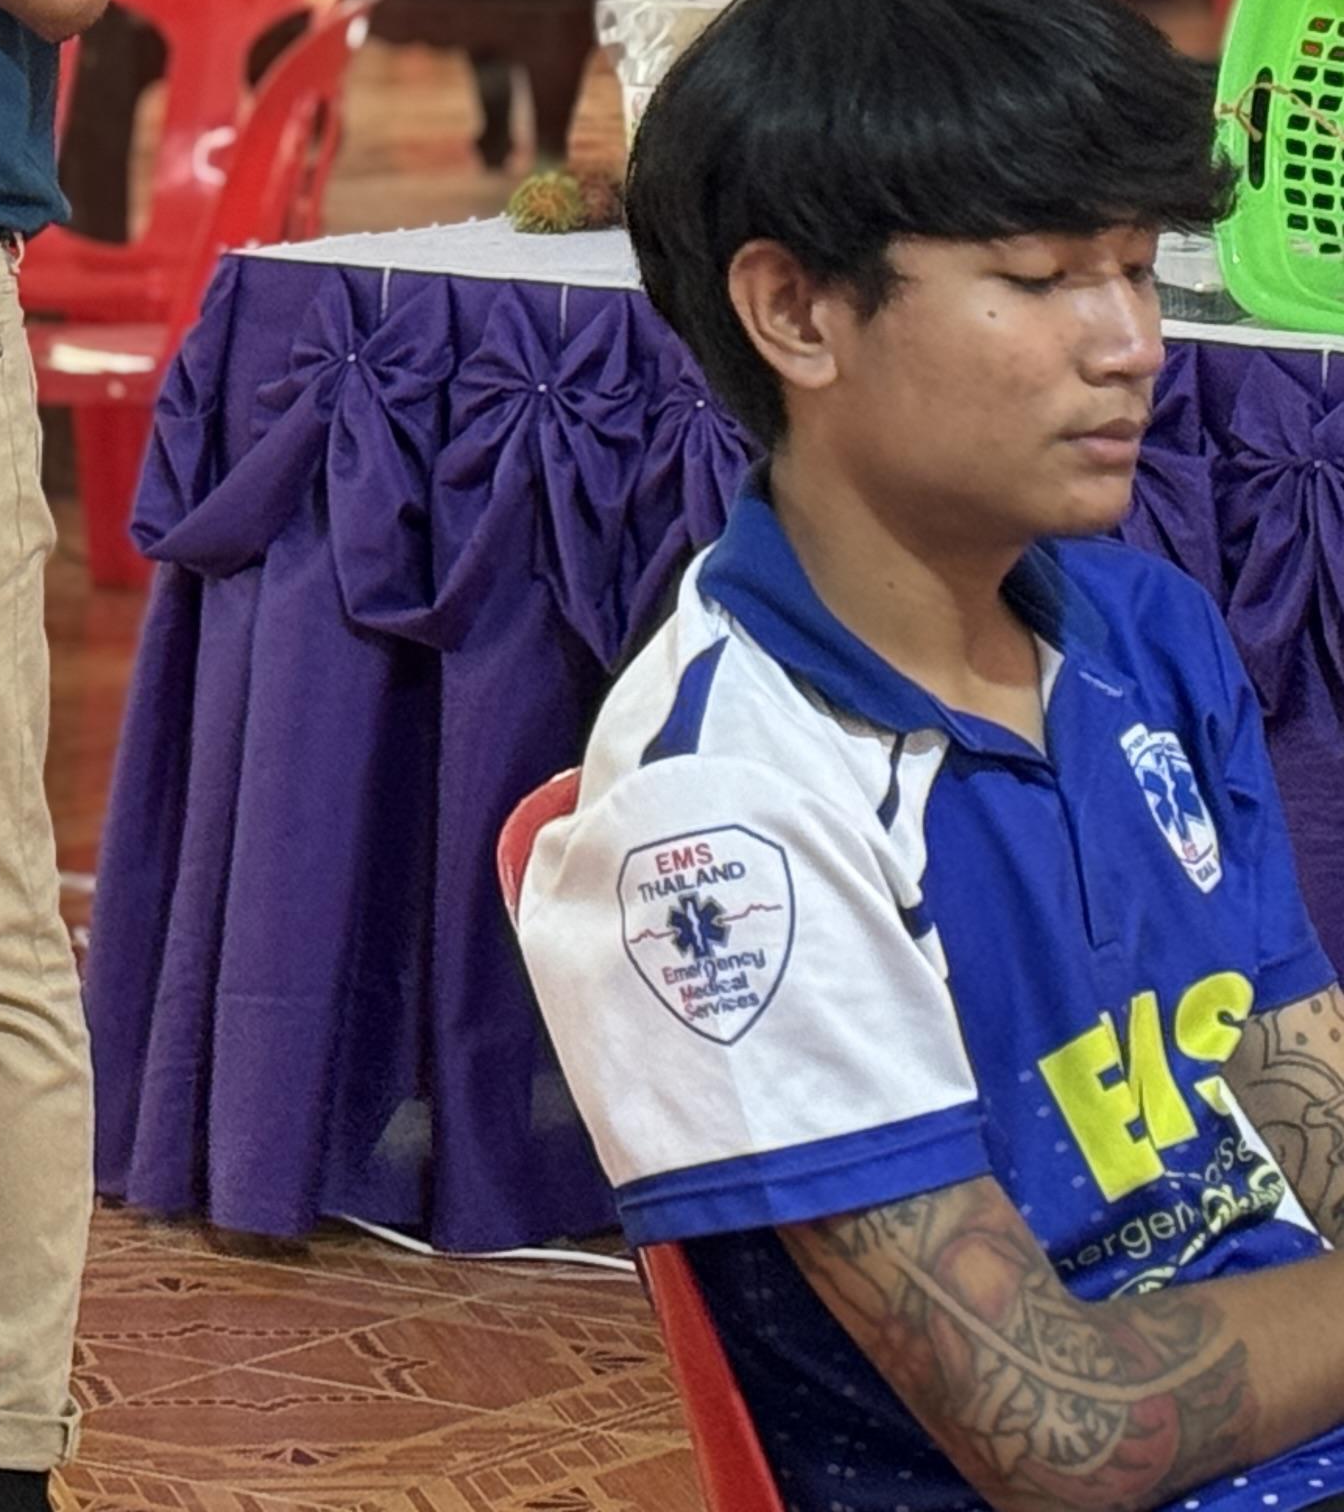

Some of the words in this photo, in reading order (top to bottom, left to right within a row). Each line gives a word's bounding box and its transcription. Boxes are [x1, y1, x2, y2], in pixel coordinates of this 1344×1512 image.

[655, 843, 714, 875] EMS
[637, 861, 746, 902] THAILAND
[661, 948, 766, 985] Emergency
